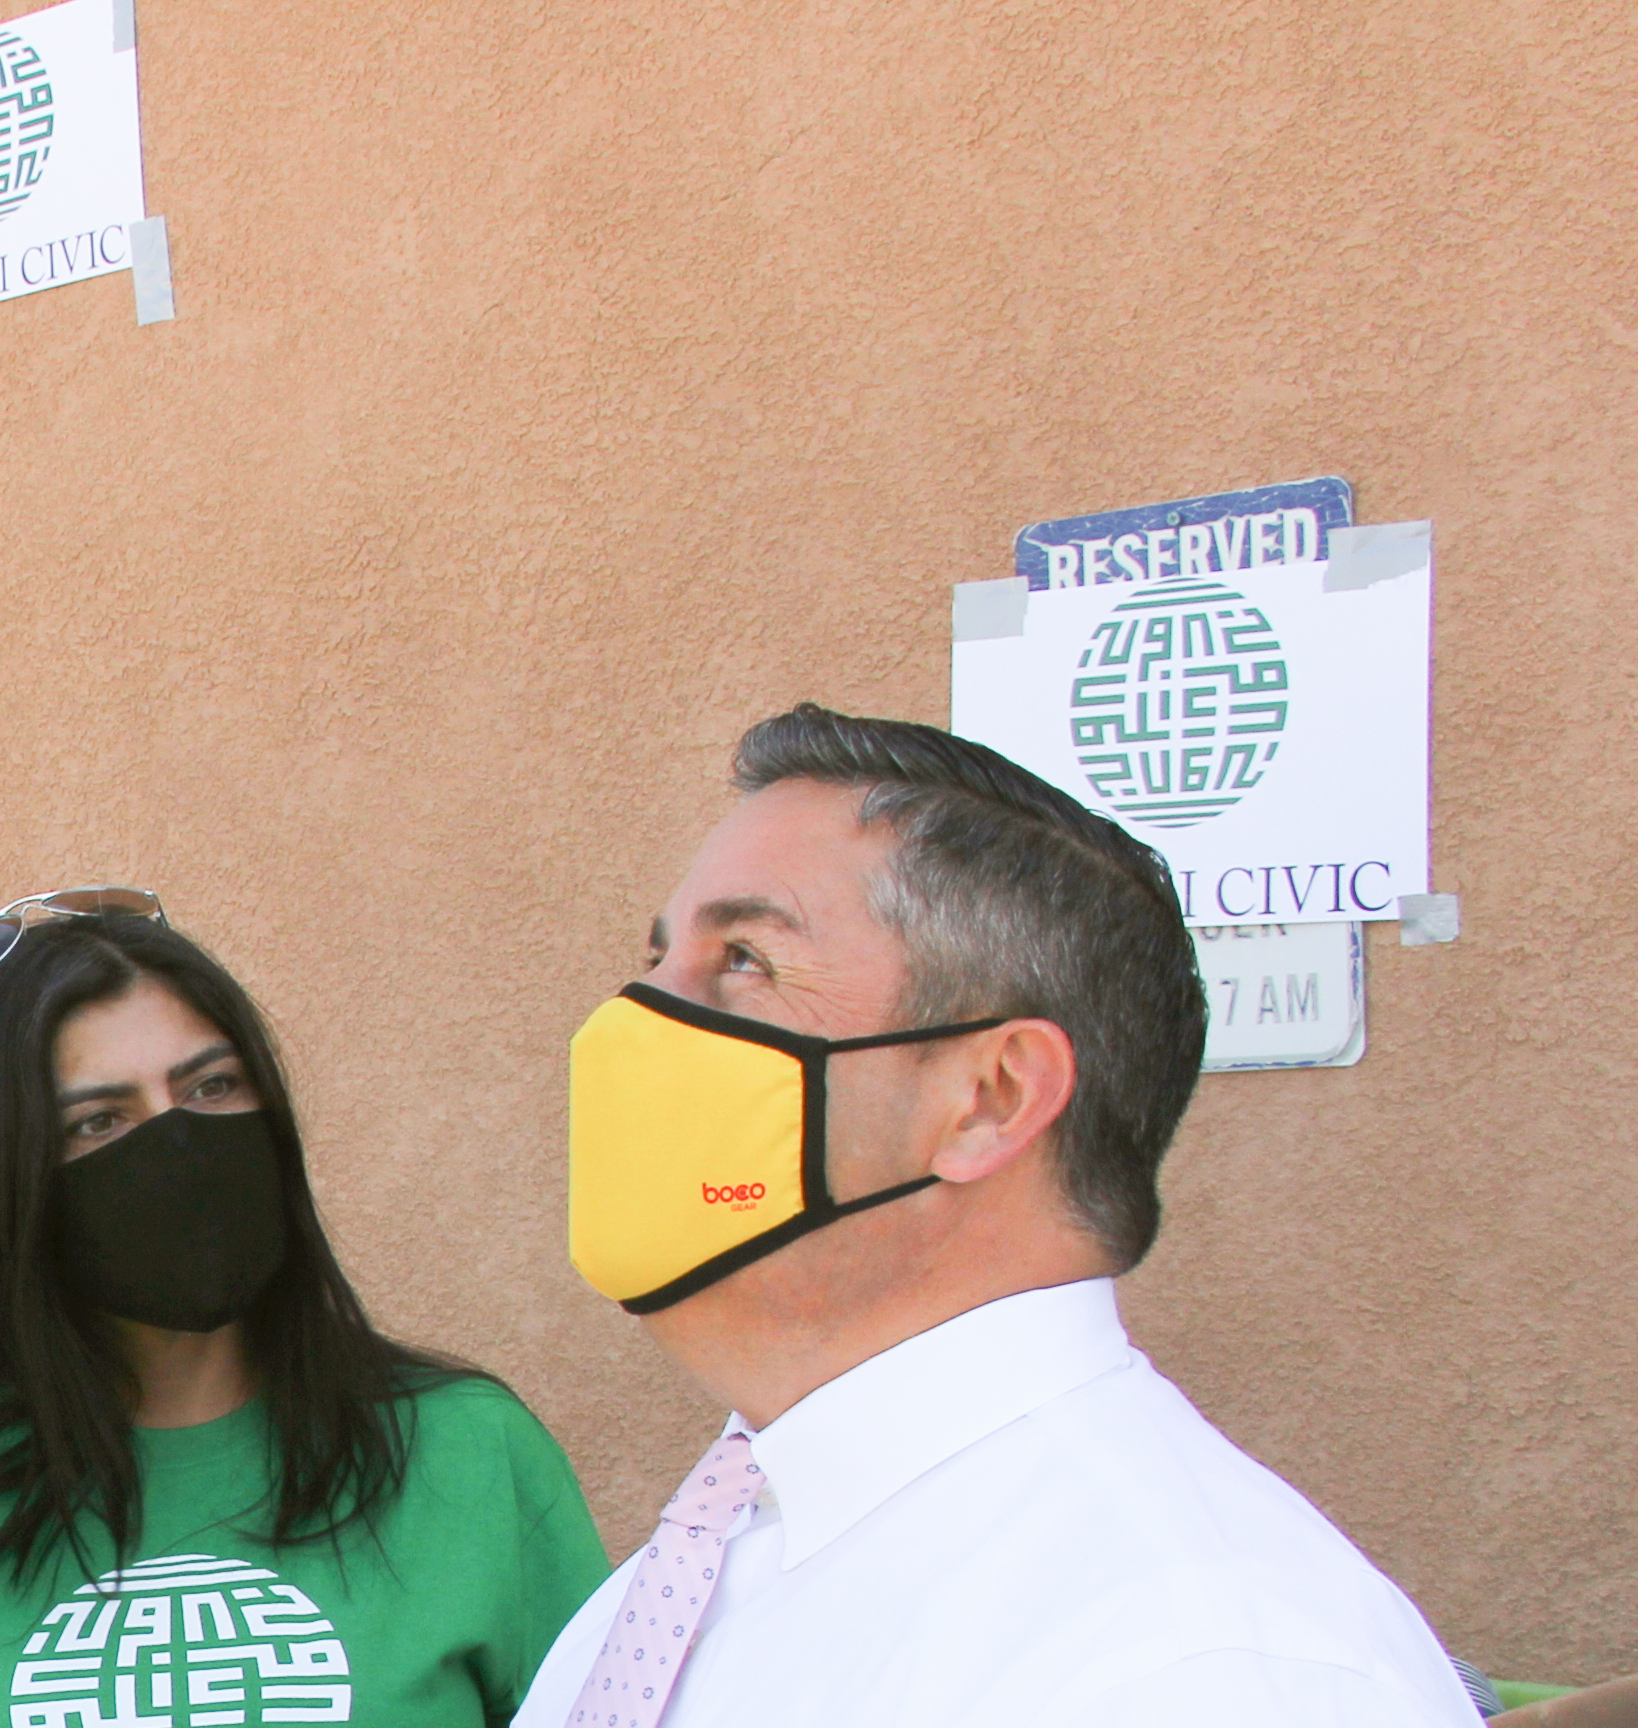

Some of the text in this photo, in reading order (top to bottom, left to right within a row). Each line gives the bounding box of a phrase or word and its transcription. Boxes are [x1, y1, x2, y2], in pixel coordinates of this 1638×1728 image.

[22, 224, 125, 285] CIVIC
[1048, 507, 1319, 590] RESERVED
[1217, 860, 1394, 917] CIVIC
[1222, 973, 1320, 1027] 7 AM
[702, 1182, 765, 1204] boco
[731, 1202, 757, 1212] GEAR
